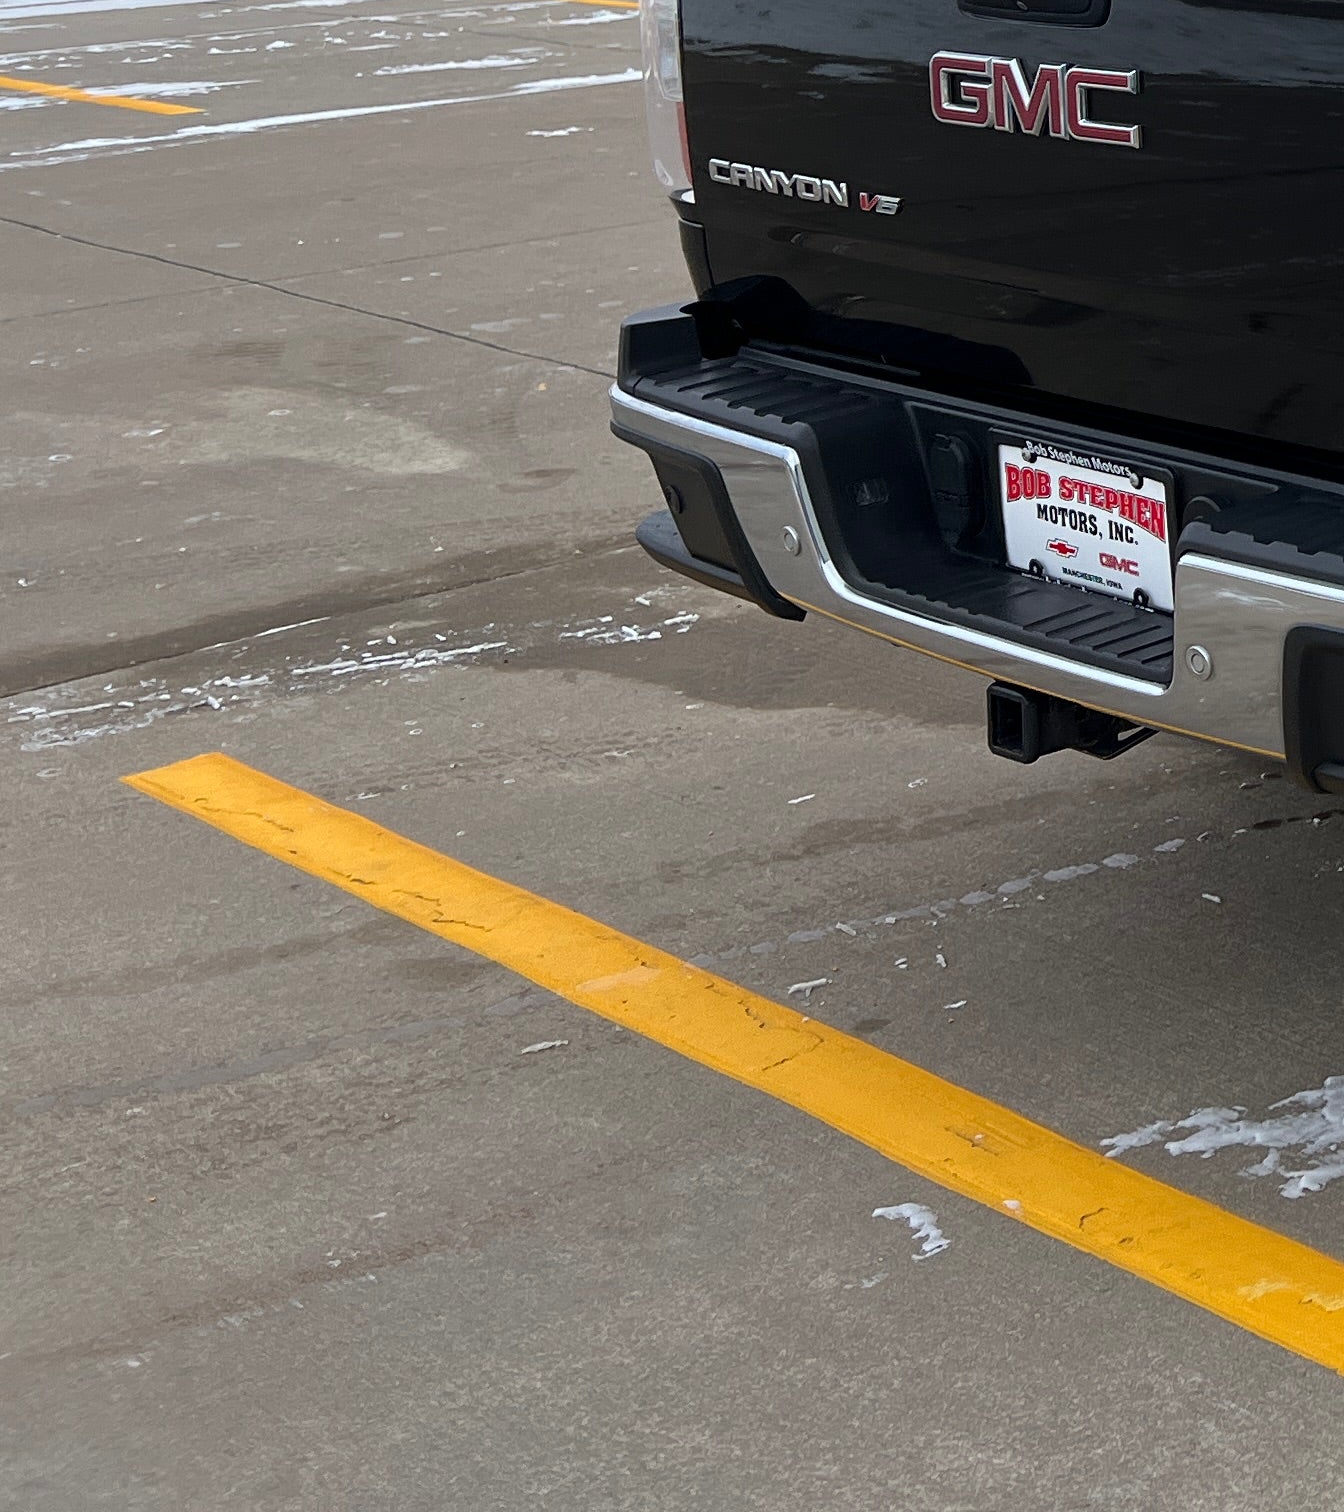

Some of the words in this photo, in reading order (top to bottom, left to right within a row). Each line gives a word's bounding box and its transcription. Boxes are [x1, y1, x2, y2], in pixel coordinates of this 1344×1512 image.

[929, 49, 1143, 150] GMC
[708, 158, 849, 208] CANYON
[859, 191, 904, 215] V6
[1025, 440, 1048, 457] Bob
[1047, 446, 1092, 467] Stephen
[1091, 456, 1133, 477] Motors
[1005, 462, 1052, 502] BOB
[1058, 476, 1167, 543] STEPHEN
[1036, 503, 1103, 540] MOTORS,
[1108, 519, 1139, 545] INC.
[1061, 566, 1105, 586] MANCHESTER,
[1098, 551, 1140, 577] GMC
